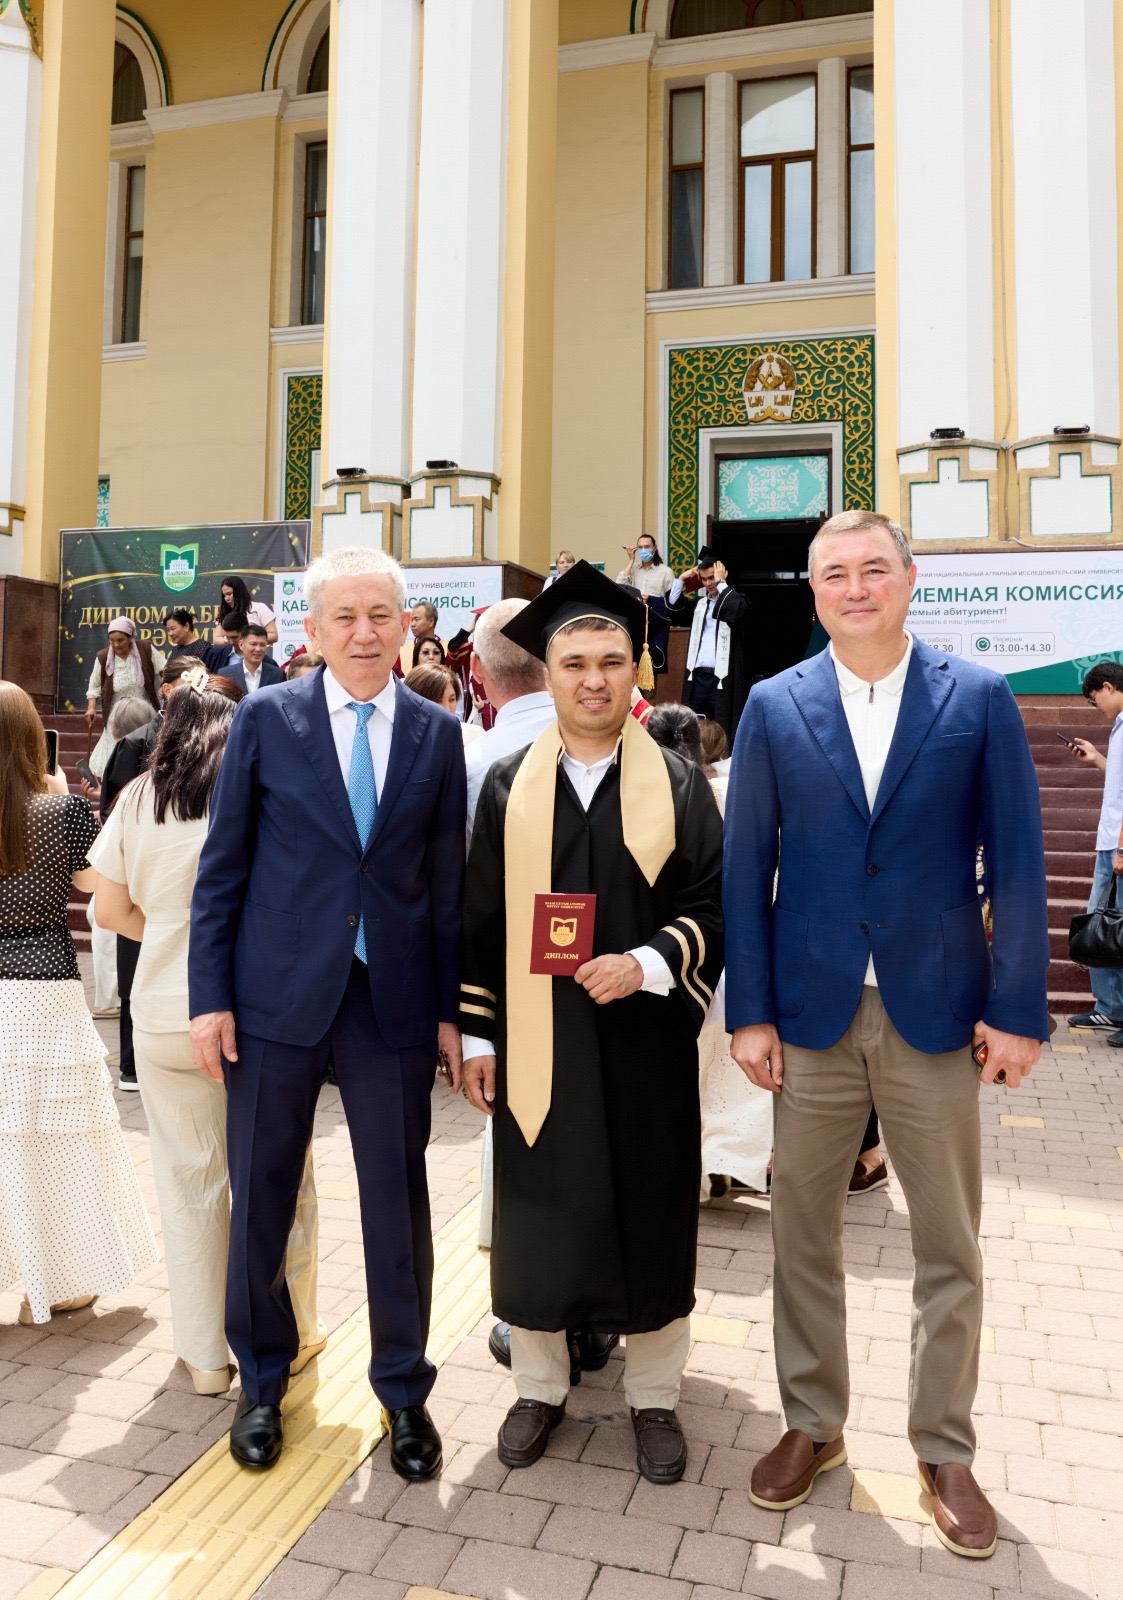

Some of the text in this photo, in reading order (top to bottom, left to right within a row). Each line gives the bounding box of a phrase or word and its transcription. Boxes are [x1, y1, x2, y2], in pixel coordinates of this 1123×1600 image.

[407, 581, 475, 590] ТЕУ УНИВЕРСИТЕТІ
[910, 584, 1123, 603] ИЕМНАЯ КОМИССИЯ
[282, 600, 309, 613] ҚАБ
[906, 606, 1007, 617] аемый абитуриент!
[78, 605, 169, 628] ДИПЛОМ
[993, 643, 1051, 653] 13.00-14.30
